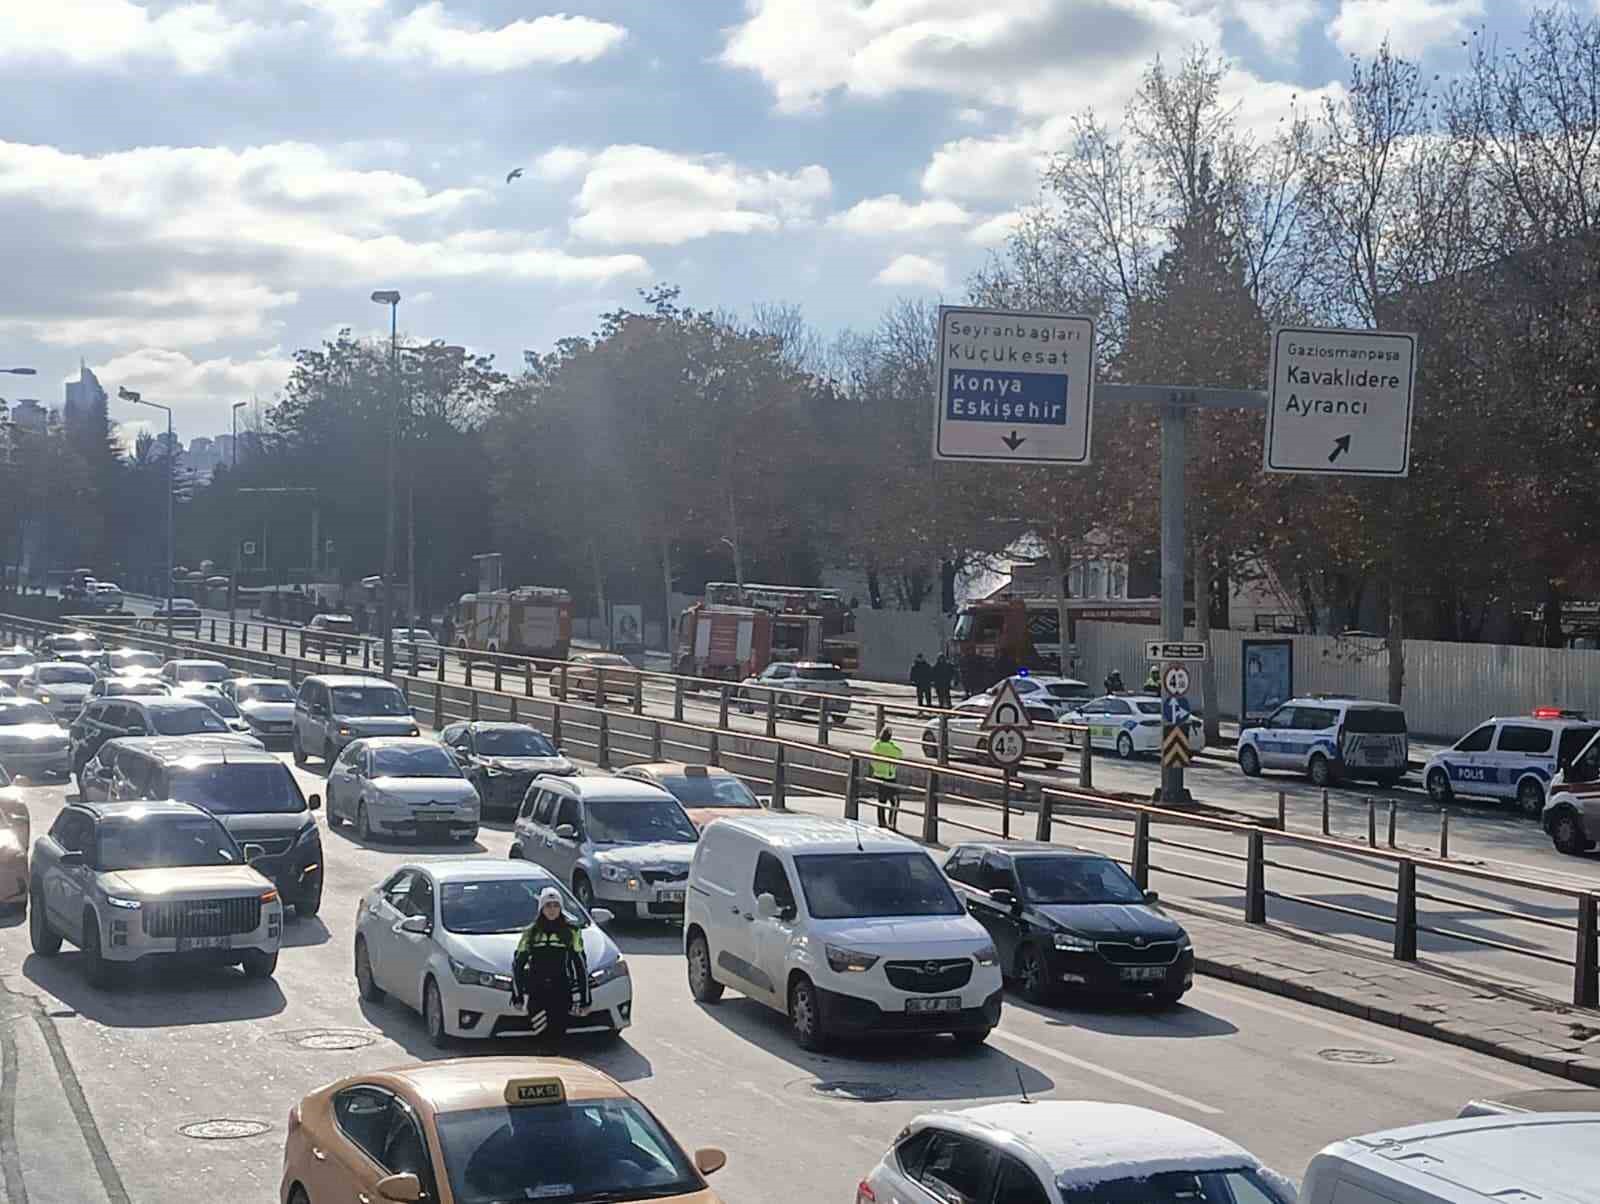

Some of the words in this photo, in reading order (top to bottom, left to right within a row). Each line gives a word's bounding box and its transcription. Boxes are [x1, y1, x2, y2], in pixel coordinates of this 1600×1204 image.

[949, 343, 1069, 365] Küçükesat
[953, 374, 1022, 397] Konya
[1287, 365, 1400, 389] Kavaklıdere
[952, 398, 1062, 421] Eskişehir
[1285, 393, 1368, 417] Ayrancı
